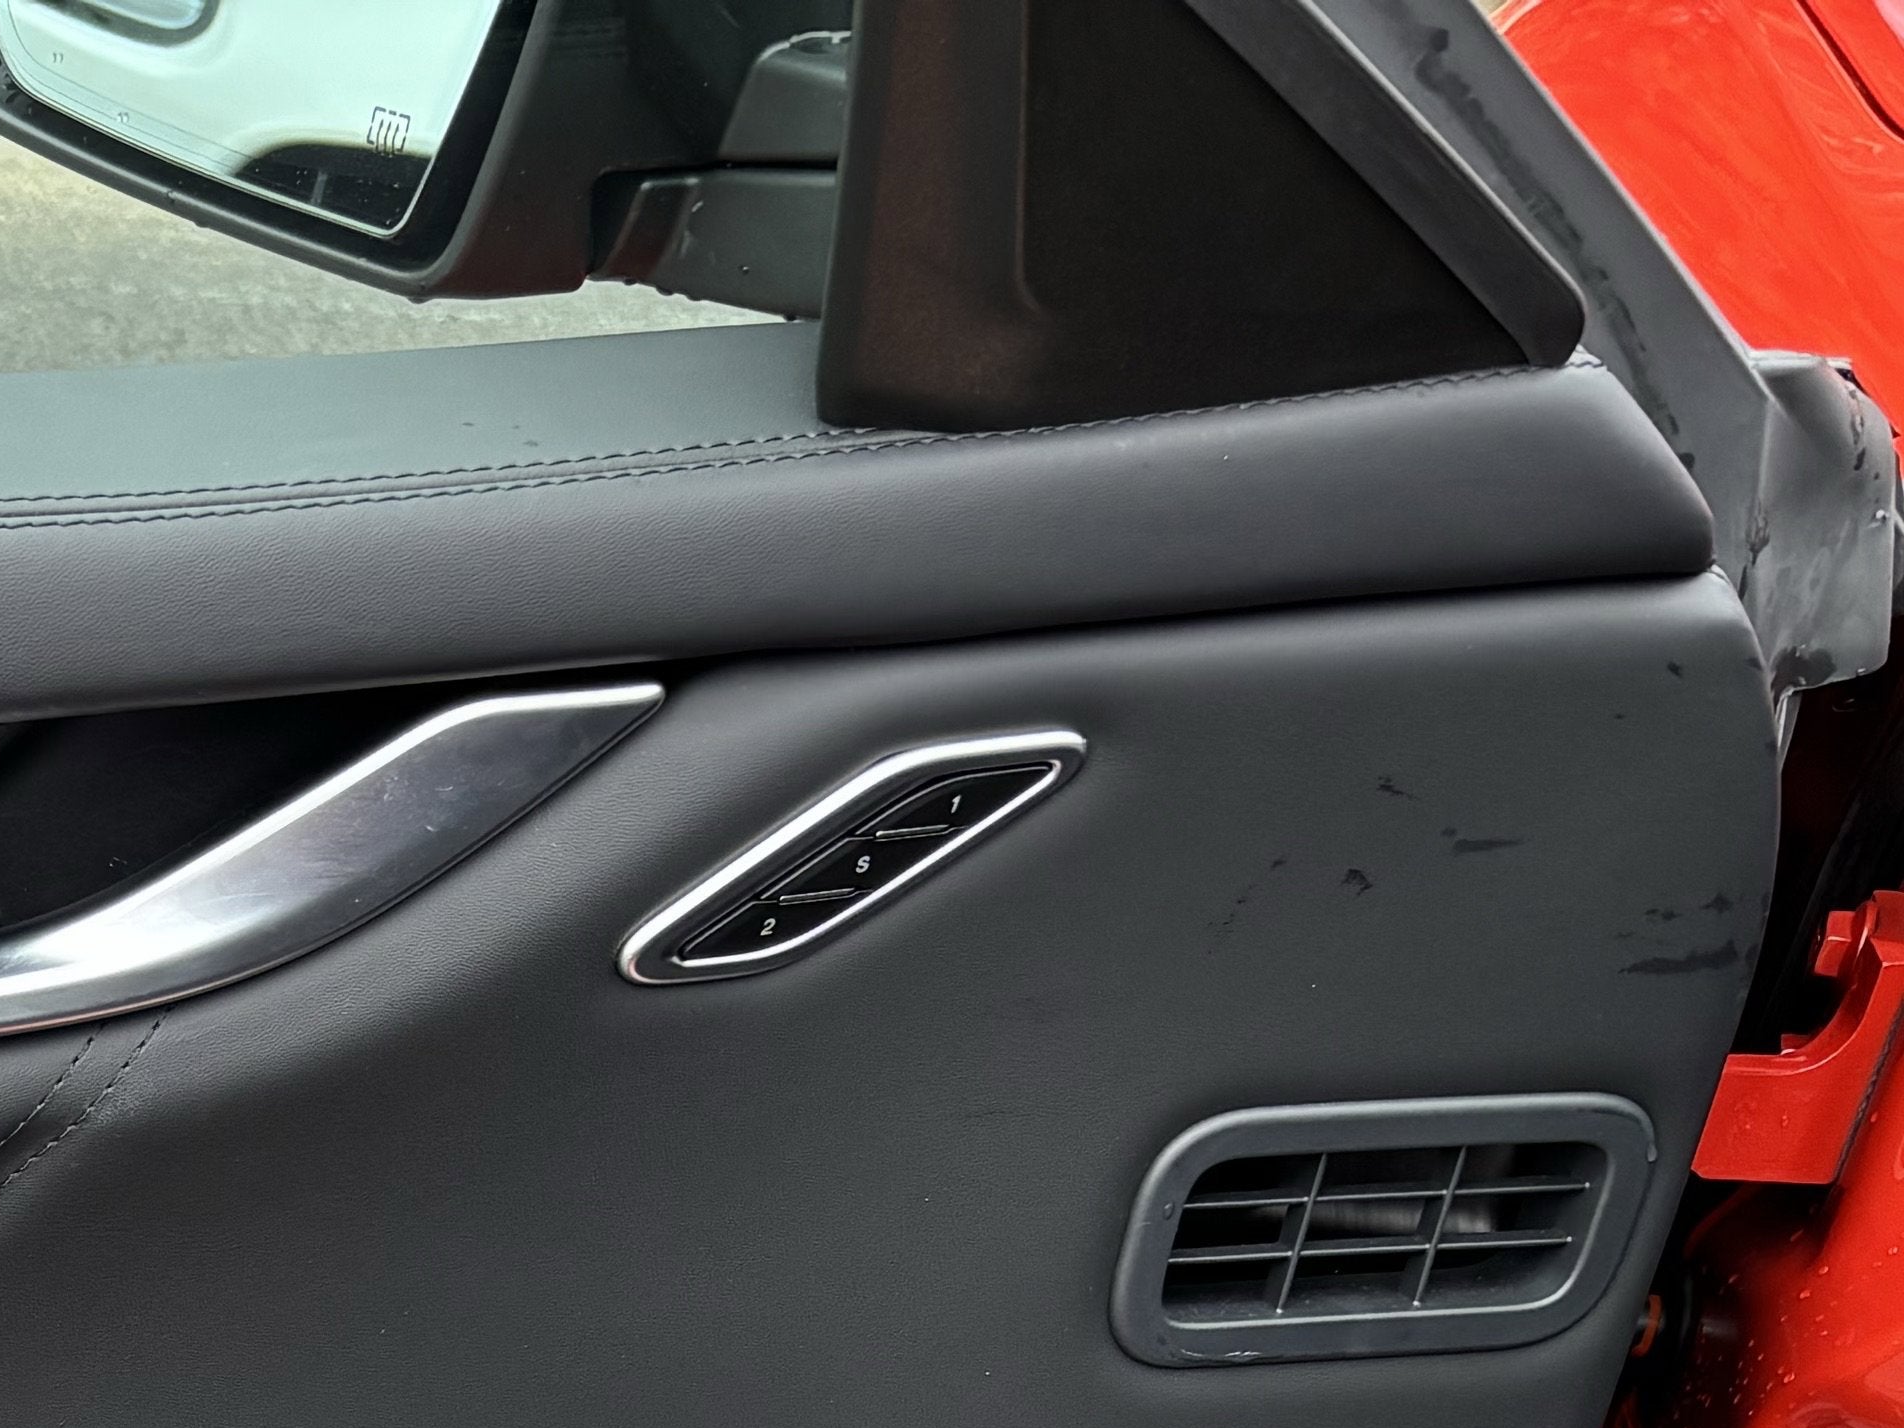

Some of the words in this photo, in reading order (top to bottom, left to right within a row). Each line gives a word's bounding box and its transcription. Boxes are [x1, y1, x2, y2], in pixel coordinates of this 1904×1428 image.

[950, 794, 962, 814] 1
[855, 855, 871, 874] S
[760, 918, 776, 936] 2
